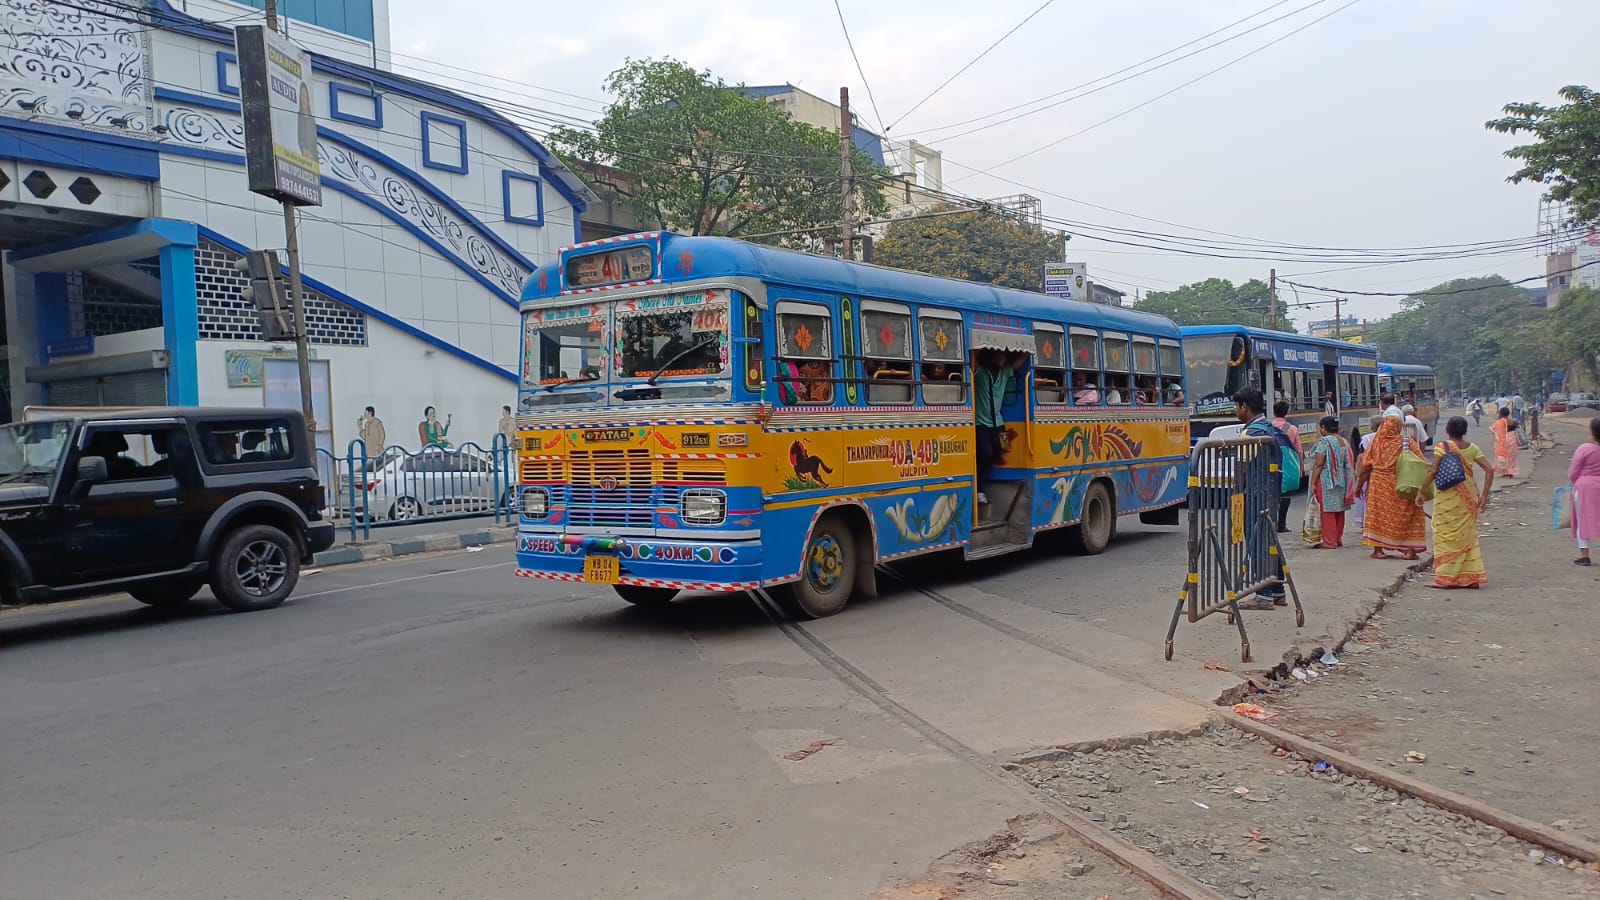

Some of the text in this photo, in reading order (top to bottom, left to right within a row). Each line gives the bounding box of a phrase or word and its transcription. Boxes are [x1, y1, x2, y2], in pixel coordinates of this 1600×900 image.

[272, 77, 298, 103] AUDIT
[900, 467, 928, 477] JULPIYA
[527, 539, 555, 553] SPEED
[656, 545, 694, 561] 40KM
[593, 559, 612, 569] WB 04
